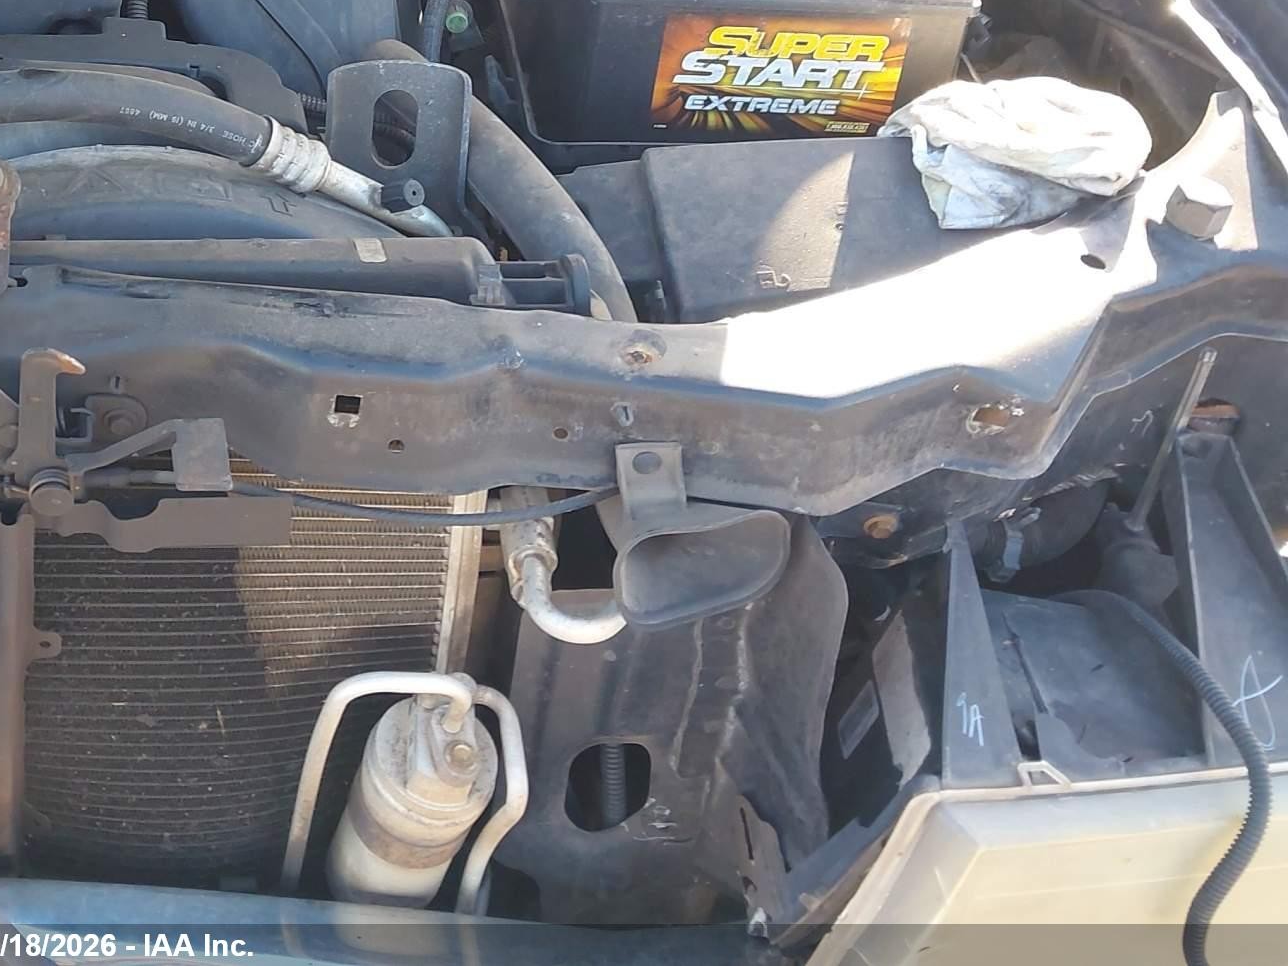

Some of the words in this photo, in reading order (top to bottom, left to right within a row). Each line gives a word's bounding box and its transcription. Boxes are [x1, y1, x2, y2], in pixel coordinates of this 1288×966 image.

[704, 26, 890, 62] SUPER
[672, 50, 886, 90] START
[684, 94, 841, 115] EXTREME
[221, 130, 246, 147] HOSE
